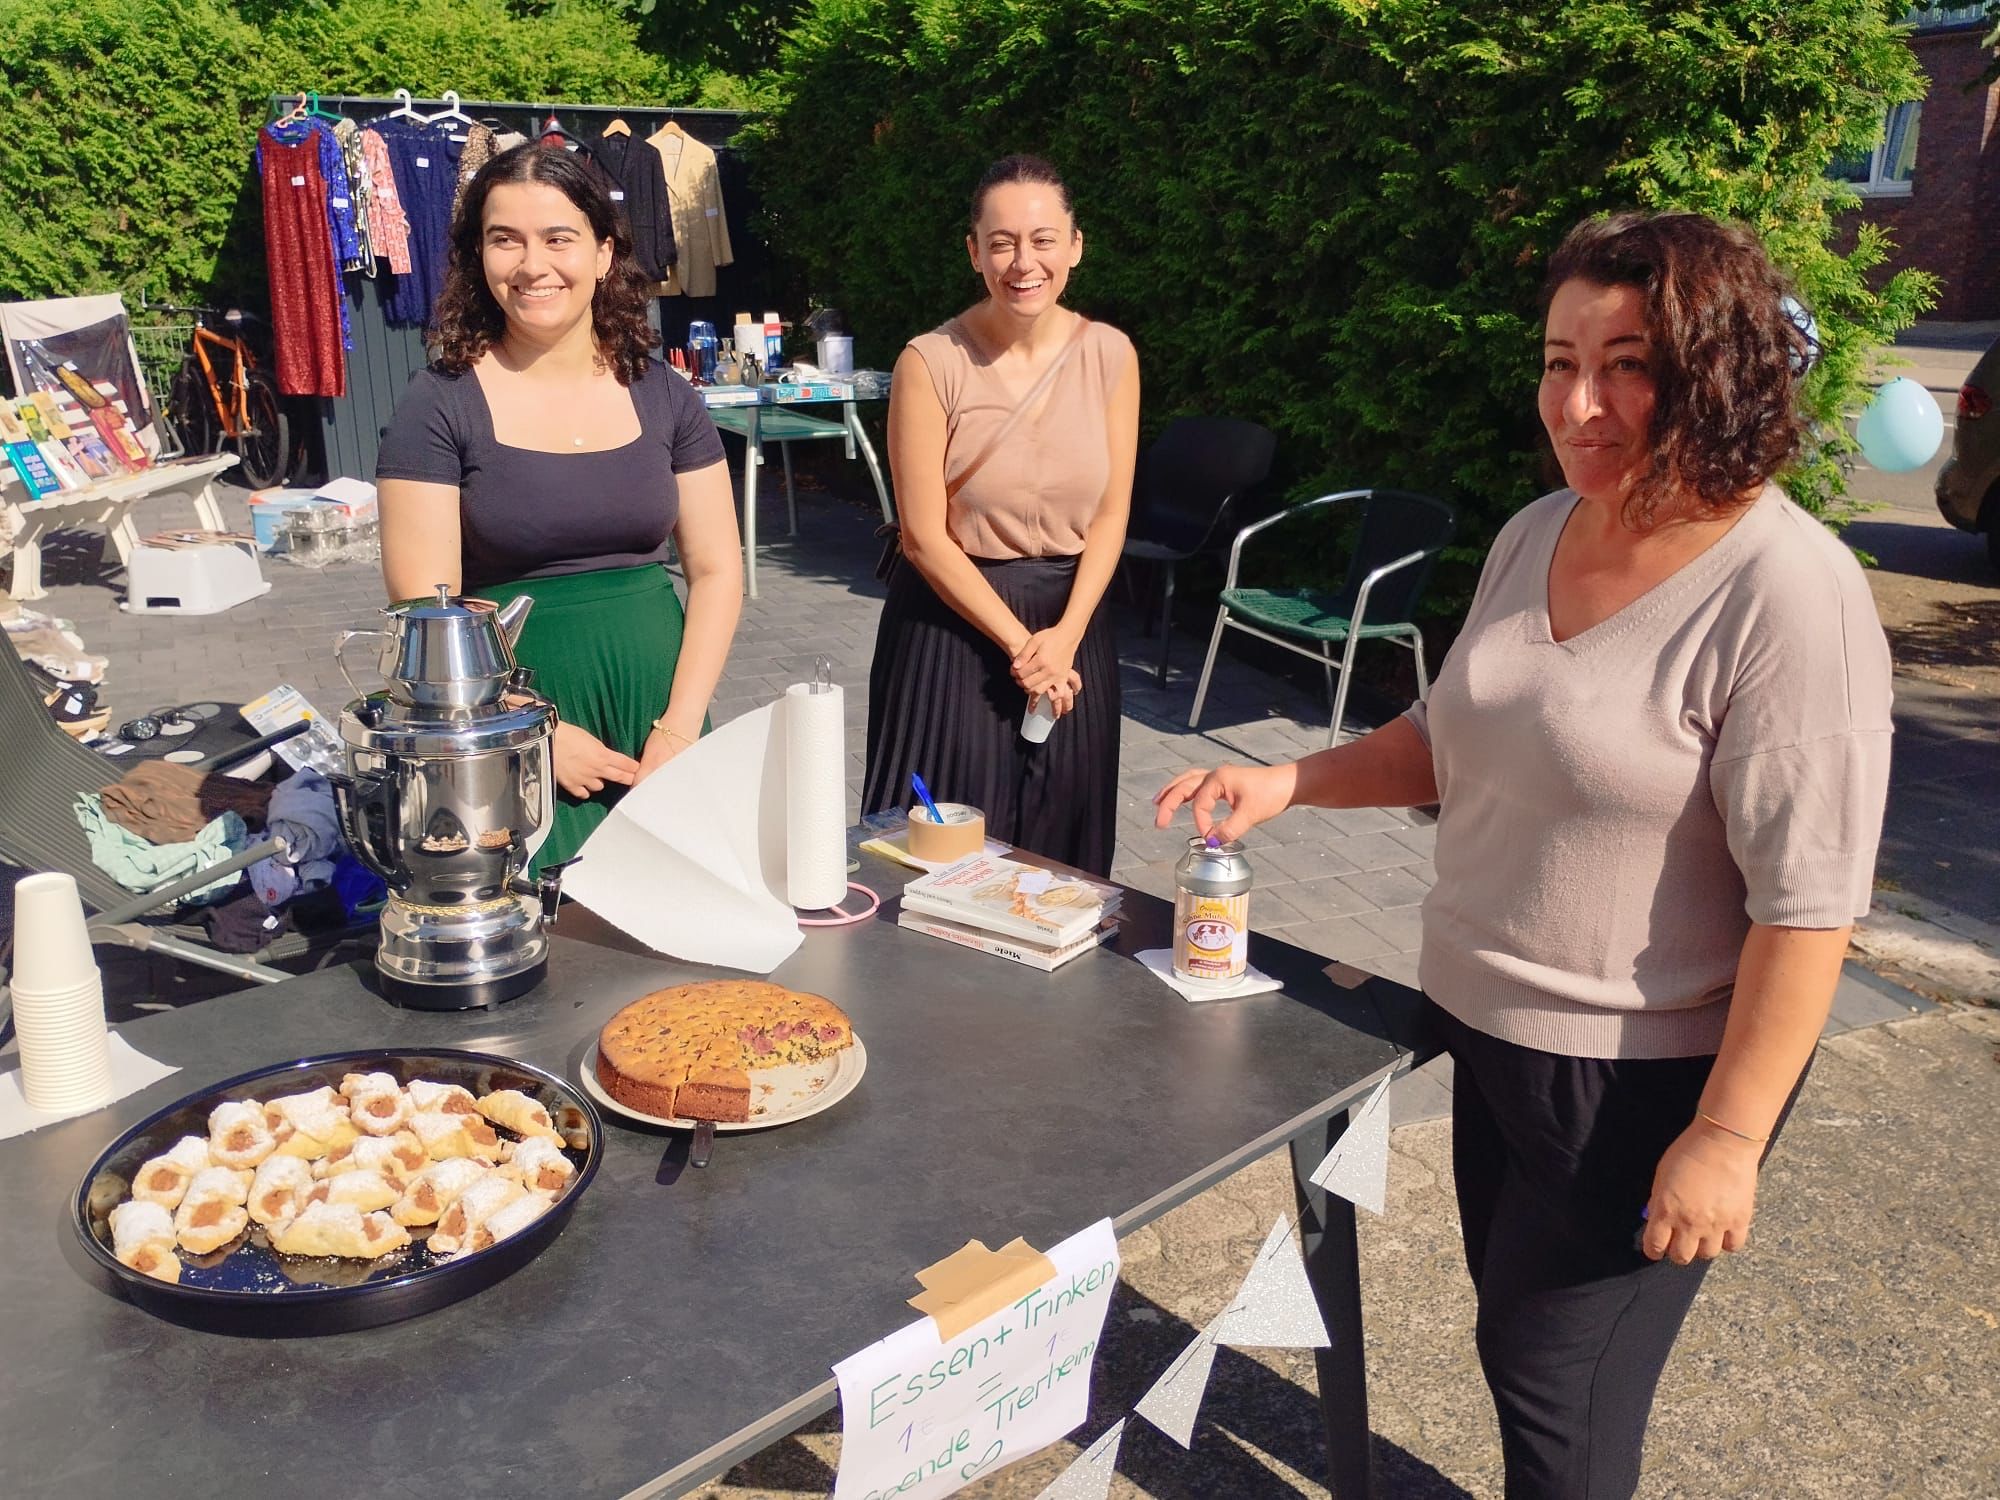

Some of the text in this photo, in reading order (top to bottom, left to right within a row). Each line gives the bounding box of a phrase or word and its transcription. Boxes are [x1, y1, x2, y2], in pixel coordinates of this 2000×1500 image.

[994, 946, 1021, 960] Miele
[870, 1336, 988, 1429] Essen
[1014, 1260, 1114, 1330] Trinken
[984, 1340, 1095, 1430] Tierheim
